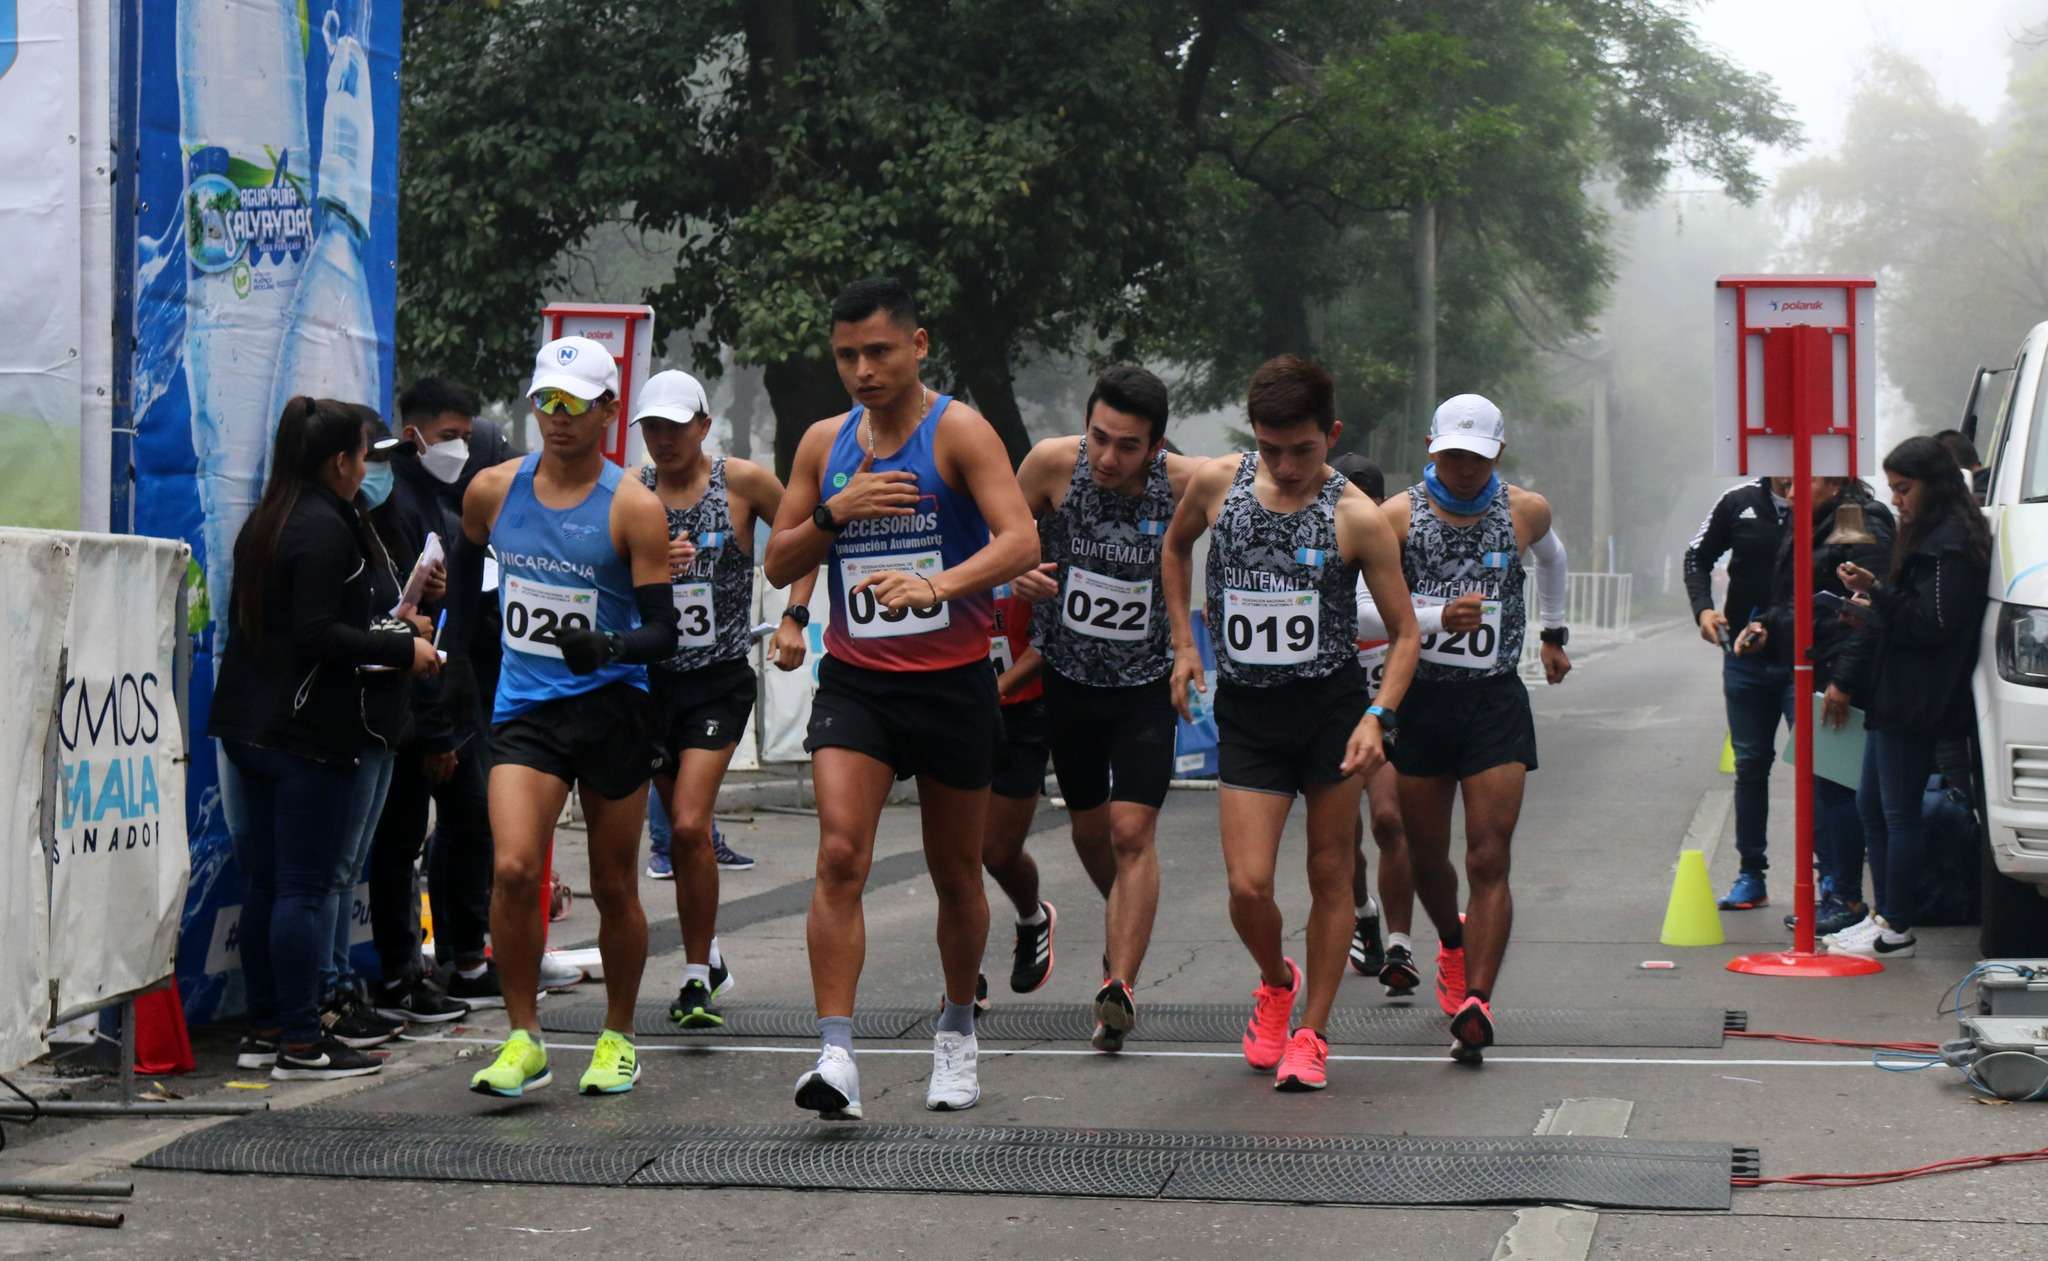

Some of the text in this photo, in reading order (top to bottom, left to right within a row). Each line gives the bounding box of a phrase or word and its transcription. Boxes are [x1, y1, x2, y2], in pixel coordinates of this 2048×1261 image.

[240, 187, 297, 206] AGUA PURA
[224, 207, 313, 258] SALVAVIDAS
[1781, 300, 1824, 312] polanik
[561, 349, 573, 359] N
[839, 512, 938, 539] ACCESORIOS
[889, 534, 943, 550] Automotriz
[1071, 537, 1155, 564] GUATEMALA
[1224, 566, 1314, 592] GUATEMALA
[1067, 590, 1147, 630] 022
[1228, 614, 1314, 652] 019
